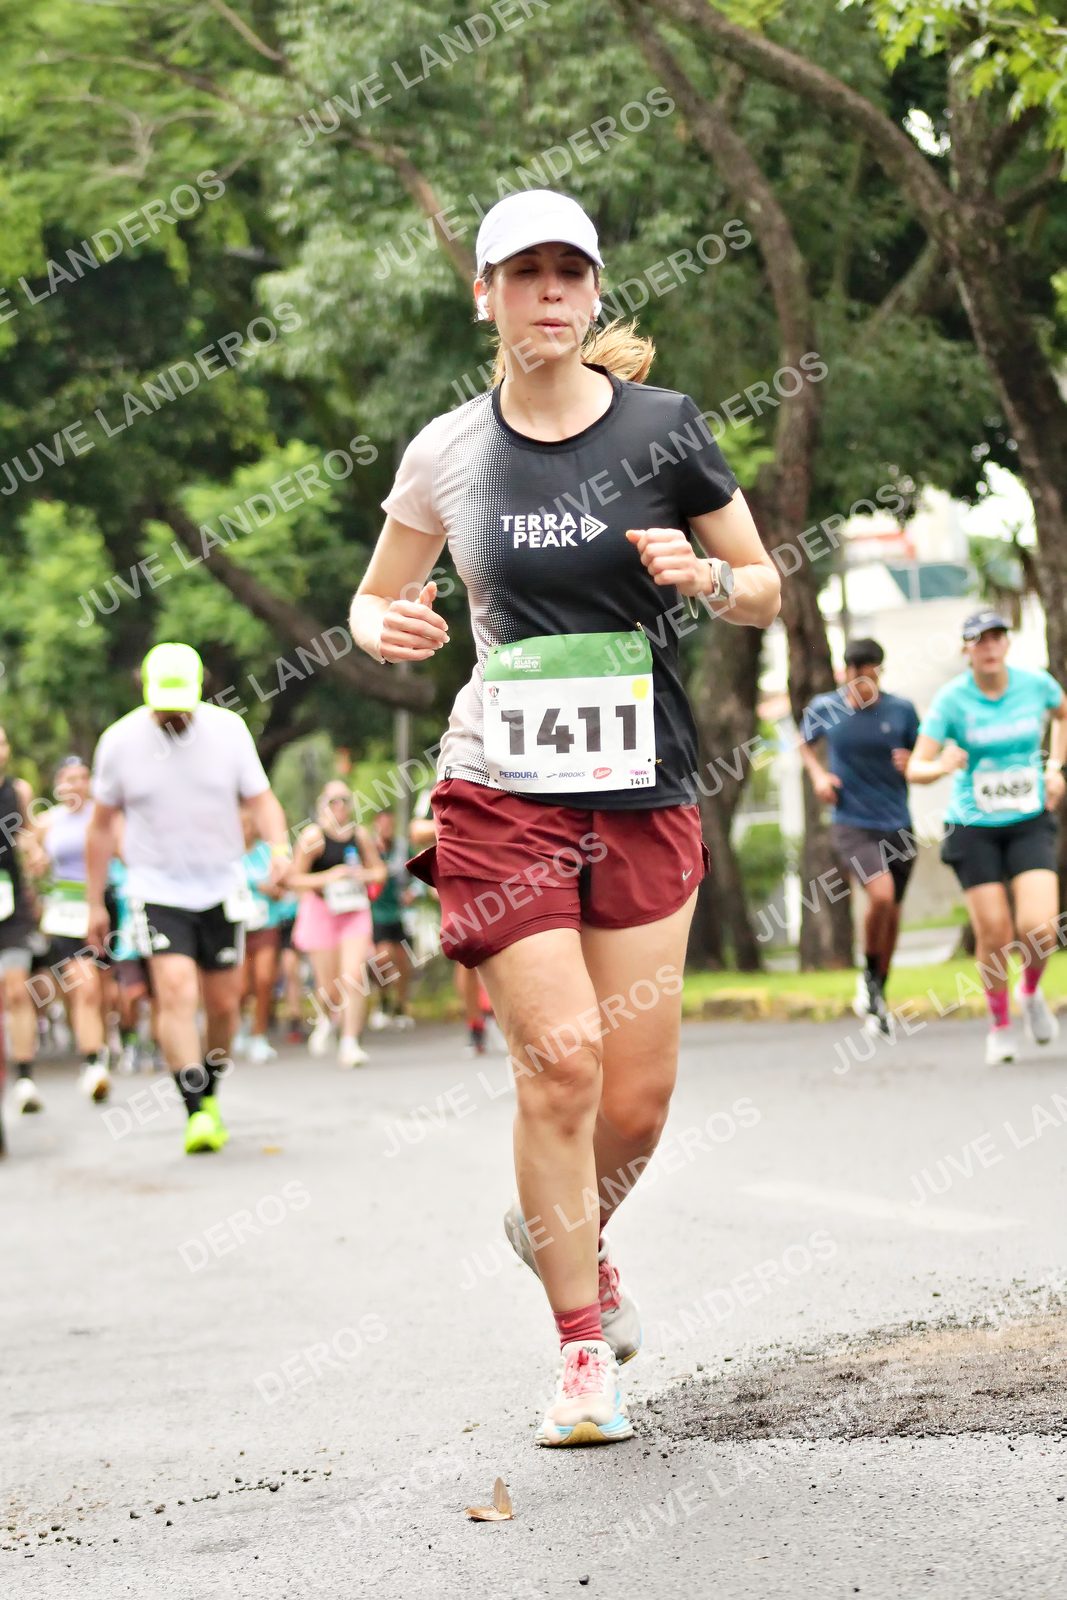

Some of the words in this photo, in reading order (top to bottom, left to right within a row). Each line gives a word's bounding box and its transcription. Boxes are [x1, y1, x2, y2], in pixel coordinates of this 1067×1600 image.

[500, 512, 578, 532] TERRA
[513, 529, 579, 549] PEAK
[500, 704, 637, 756] 1411
[498, 770, 539, 779] PERDURA
[558, 771, 586, 779] BROOKS
[630, 776, 650, 786] 1411
